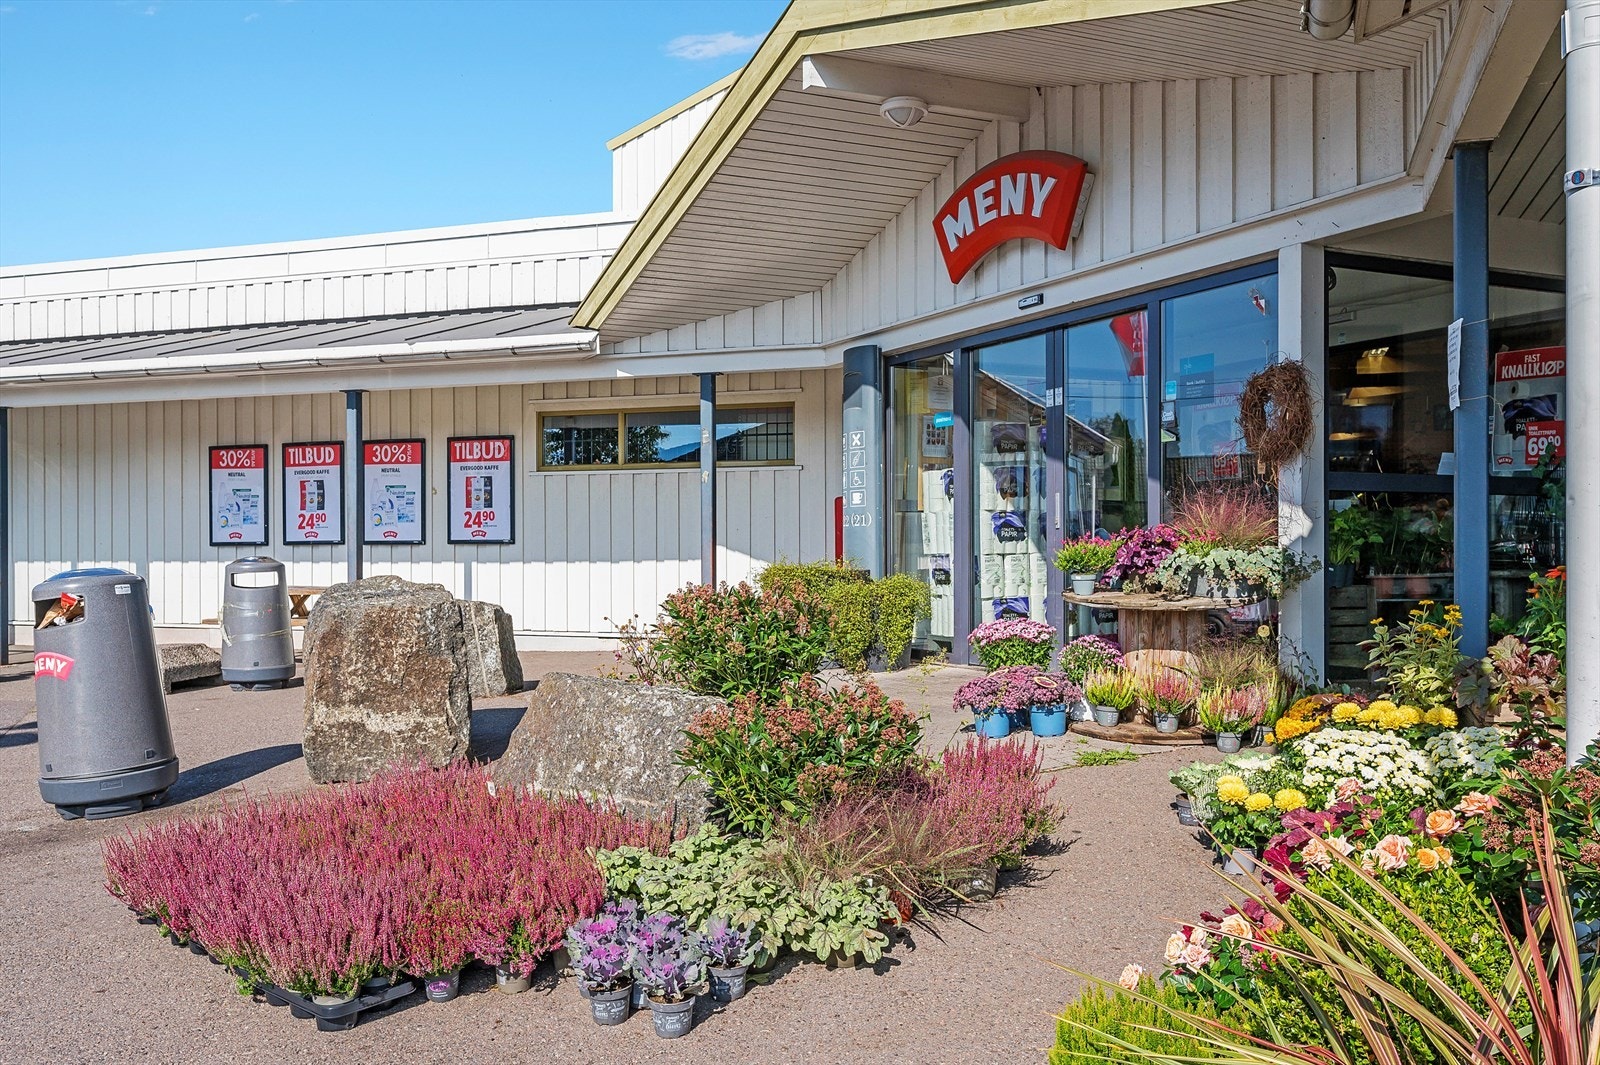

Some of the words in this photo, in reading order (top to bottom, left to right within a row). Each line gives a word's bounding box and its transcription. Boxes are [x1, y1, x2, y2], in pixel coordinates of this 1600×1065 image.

[942, 173, 1057, 252] MENY
[1524, 354, 1541, 363] FAST
[1501, 360, 1565, 379] KNALLKJØP
[219, 450, 250, 467] 30%
[288, 447, 335, 464] TILBUD
[372, 444, 406, 463] 30%
[455, 441, 505, 460] TILBUD
[851, 512, 872, 527] (21)
